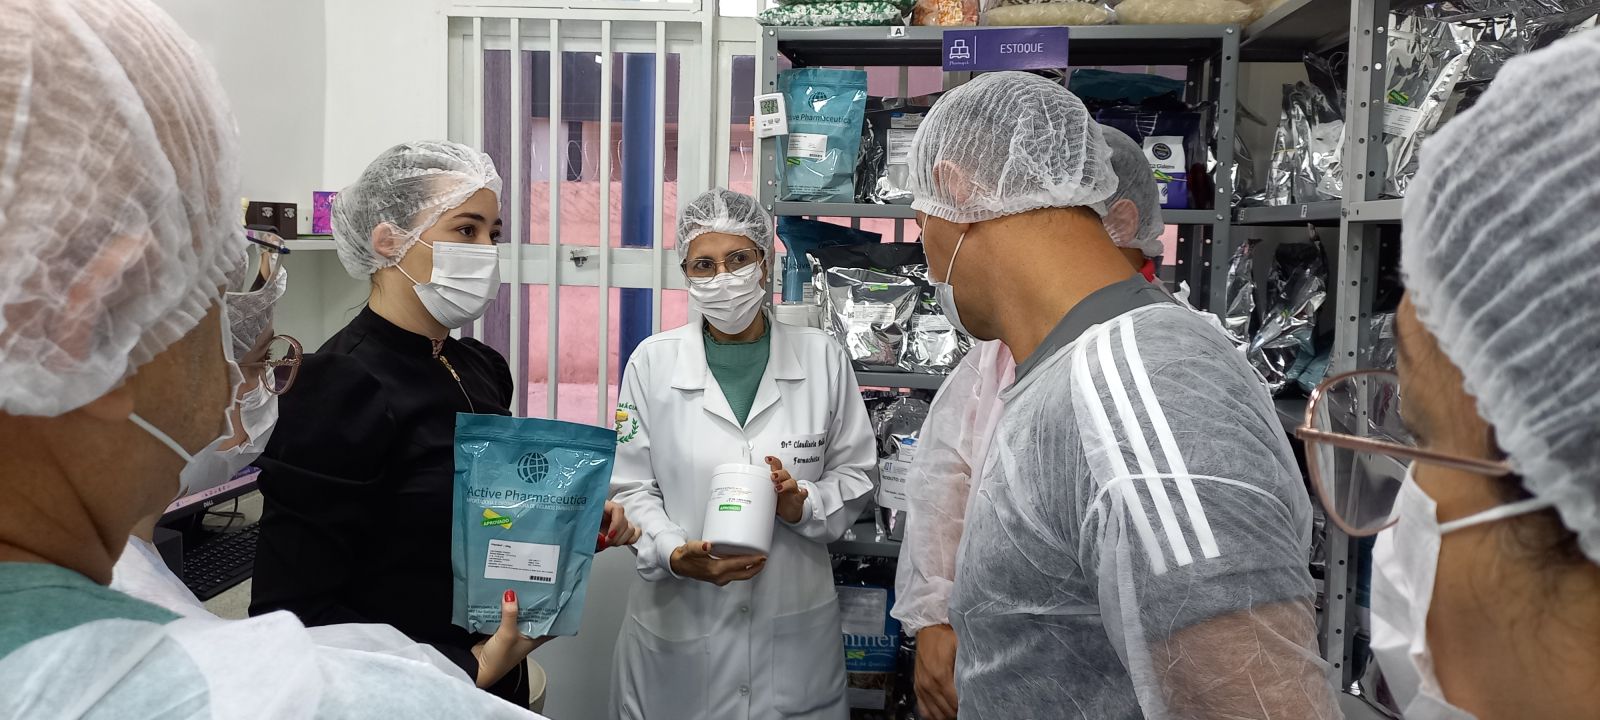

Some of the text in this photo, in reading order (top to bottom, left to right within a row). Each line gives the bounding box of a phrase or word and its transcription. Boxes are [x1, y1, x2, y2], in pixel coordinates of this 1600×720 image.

[895, 27, 902, 35] A
[1000, 42, 1044, 54] ESTOQUE
[466, 486, 588, 505] Active Pharmaceutica
[483, 518, 510, 526] APROVADO
